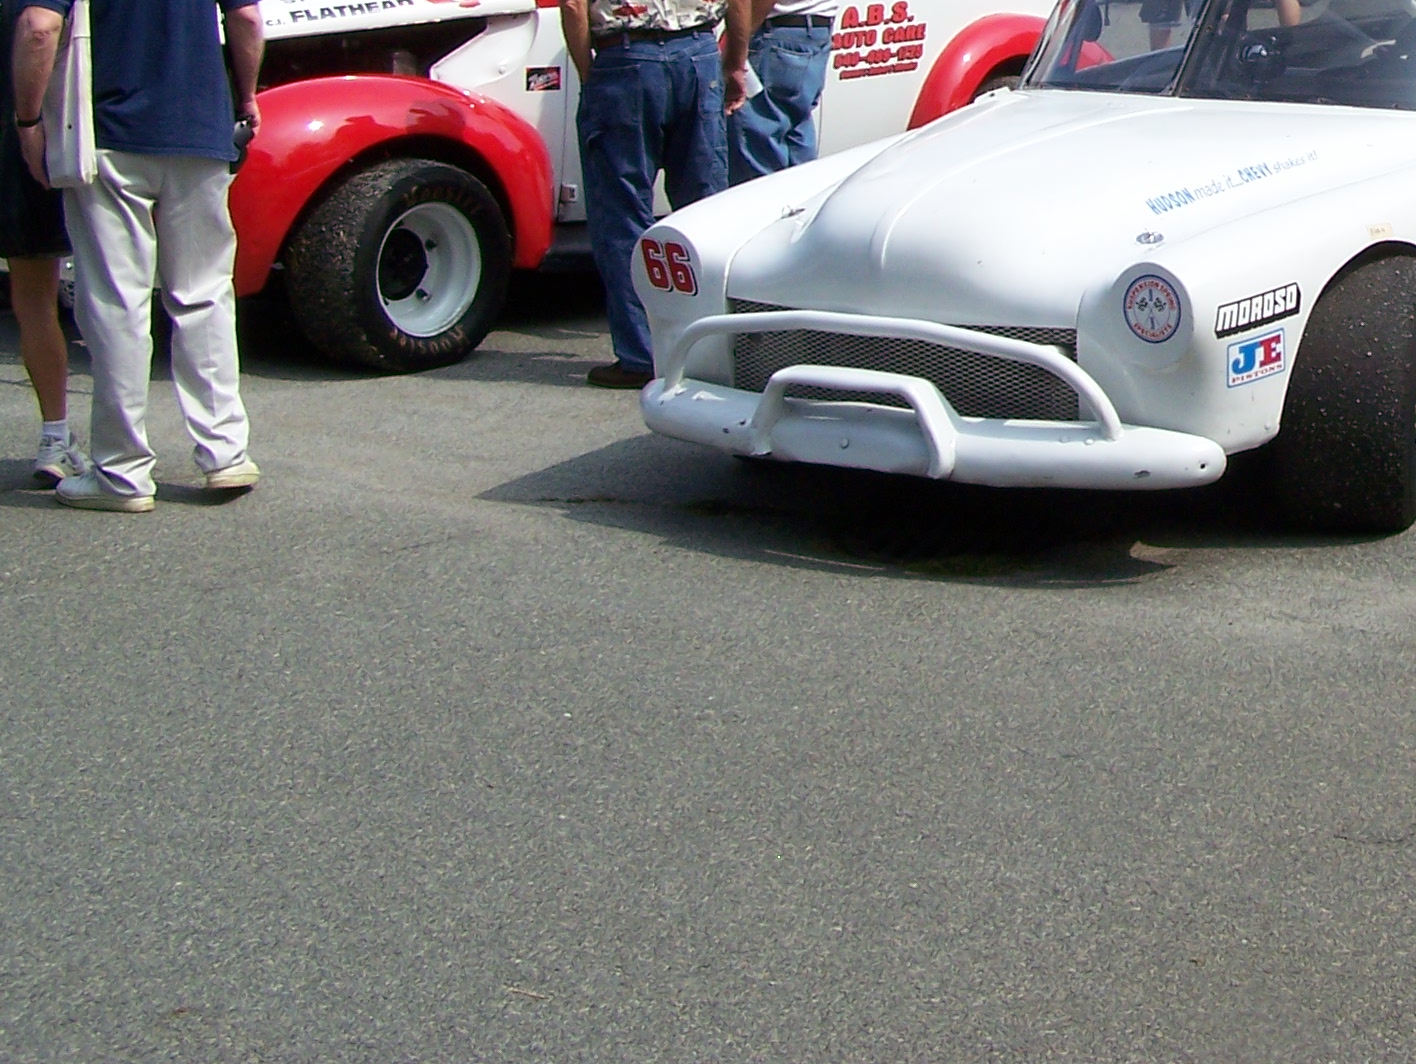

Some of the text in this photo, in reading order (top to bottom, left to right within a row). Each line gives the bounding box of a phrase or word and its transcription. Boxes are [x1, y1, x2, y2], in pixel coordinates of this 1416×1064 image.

[841, 1, 914, 29] A.B.S.
[882, 23, 927, 44] CARE
[1146, 187, 1195, 215] HUDSON
[641, 238, 698, 296] 66
[1216, 284, 1297, 332] MOROSO
[1231, 334, 1282, 375] JE
[1231, 364, 1283, 384] PISTONS
